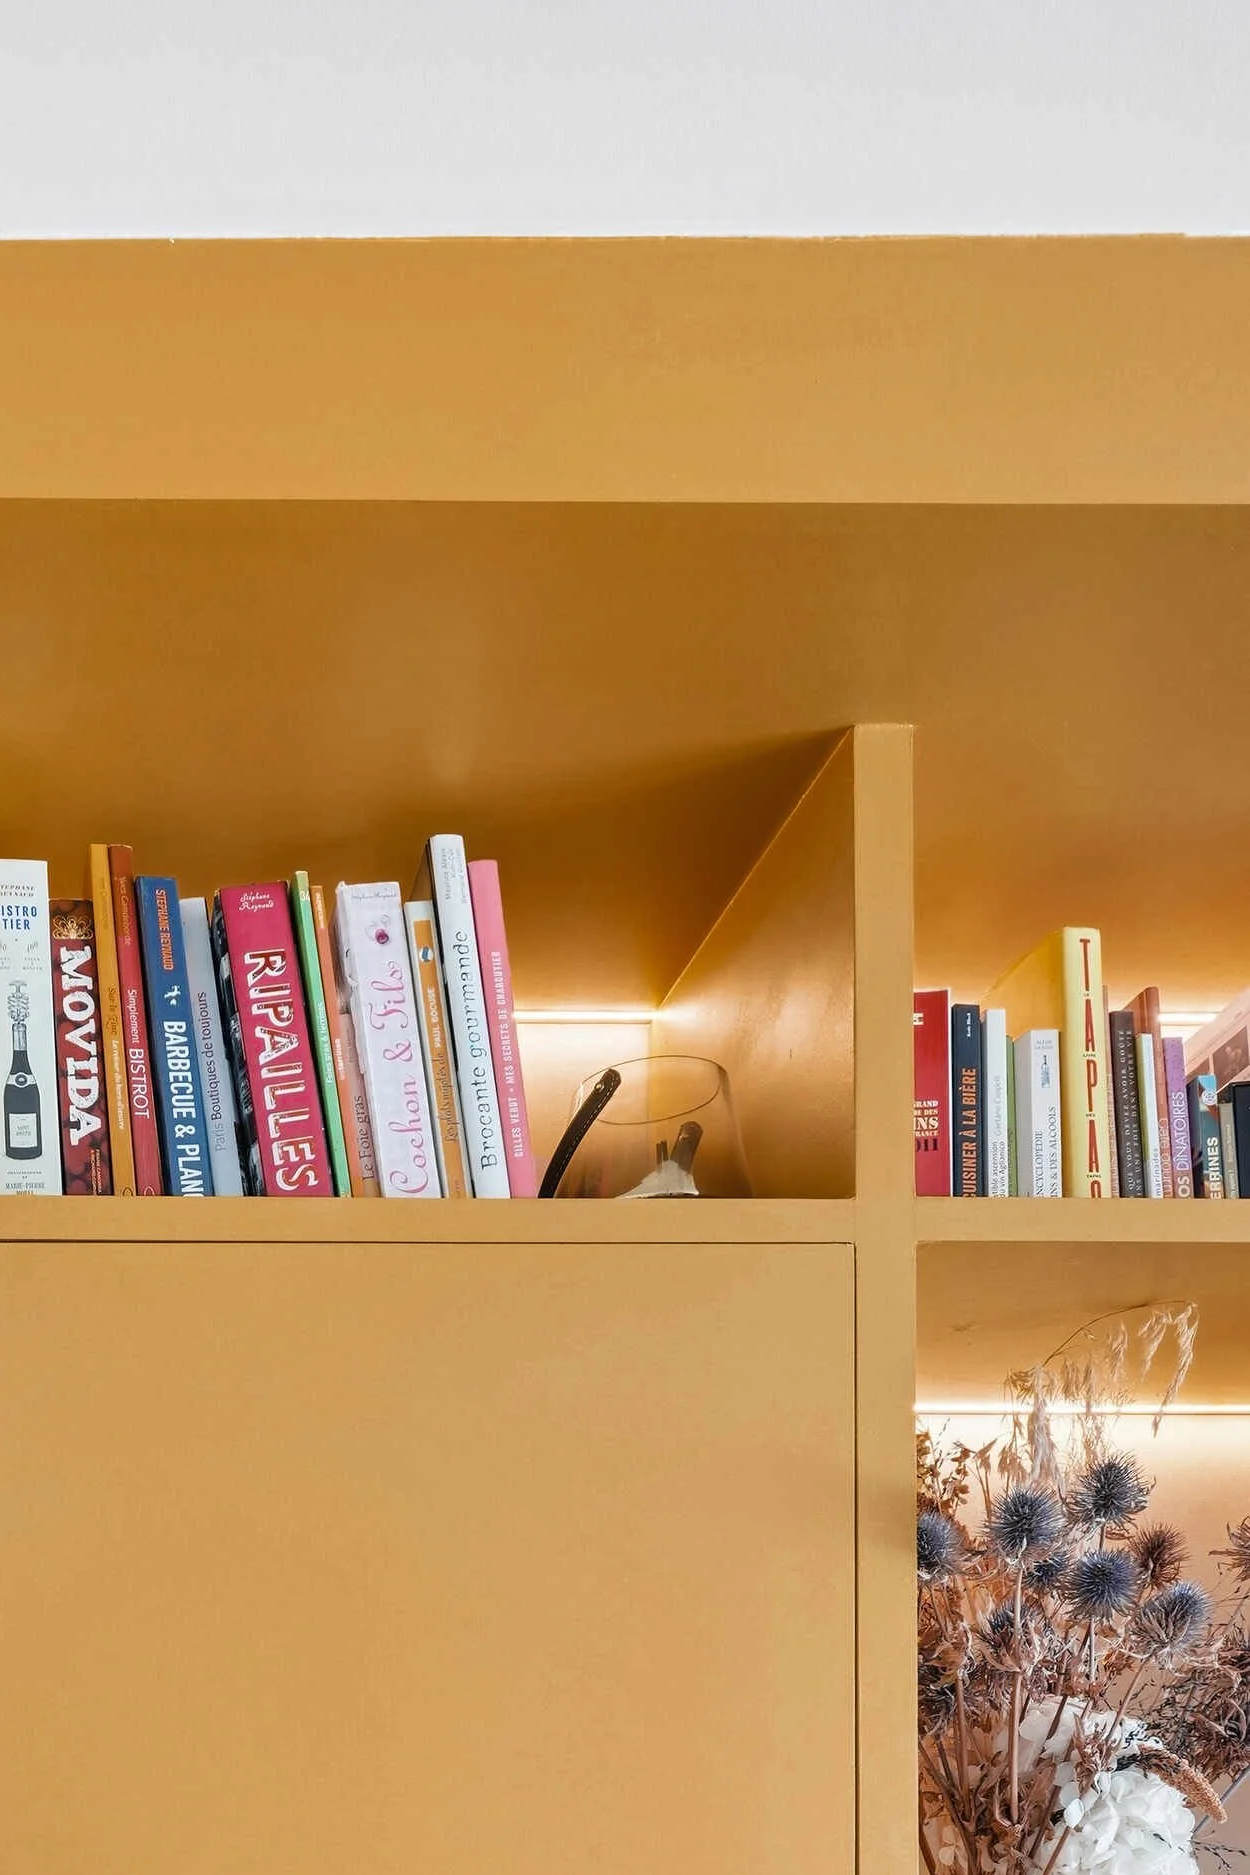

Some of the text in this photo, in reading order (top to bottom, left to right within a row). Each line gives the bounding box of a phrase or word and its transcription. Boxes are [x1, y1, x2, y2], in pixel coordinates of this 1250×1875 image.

[2, 919, 31, 930] TIER
[453, 931, 488, 1058] gourmande
[498, 1008, 509, 1019] DE
[60, 945, 101, 1146] MOVIDA
[126, 989, 150, 1120] Simplement BISTROT
[163, 1020, 196, 1119] BARBECUE
[198, 992, 227, 1151] Paris Boutiques de toujours
[245, 948, 319, 1192] RIPAILLES
[383, 1039, 413, 1062] &
[500, 1023, 514, 1062] SECRETS
[505, 1065, 516, 1084] MES
[958, 1067, 977, 1107] BIÈRE
[174, 1124, 196, 1138] &
[354, 1095, 375, 1181] Le Foie gras
[388, 1075, 429, 1194] Cochon
[471, 1065, 499, 1171] Brocante
[511, 1128, 524, 1157] GILLES
[958, 1125, 976, 1138] À
[961, 1109, 976, 1124] LA
[1171, 1091, 1190, 1171] DÎNATOIRES
